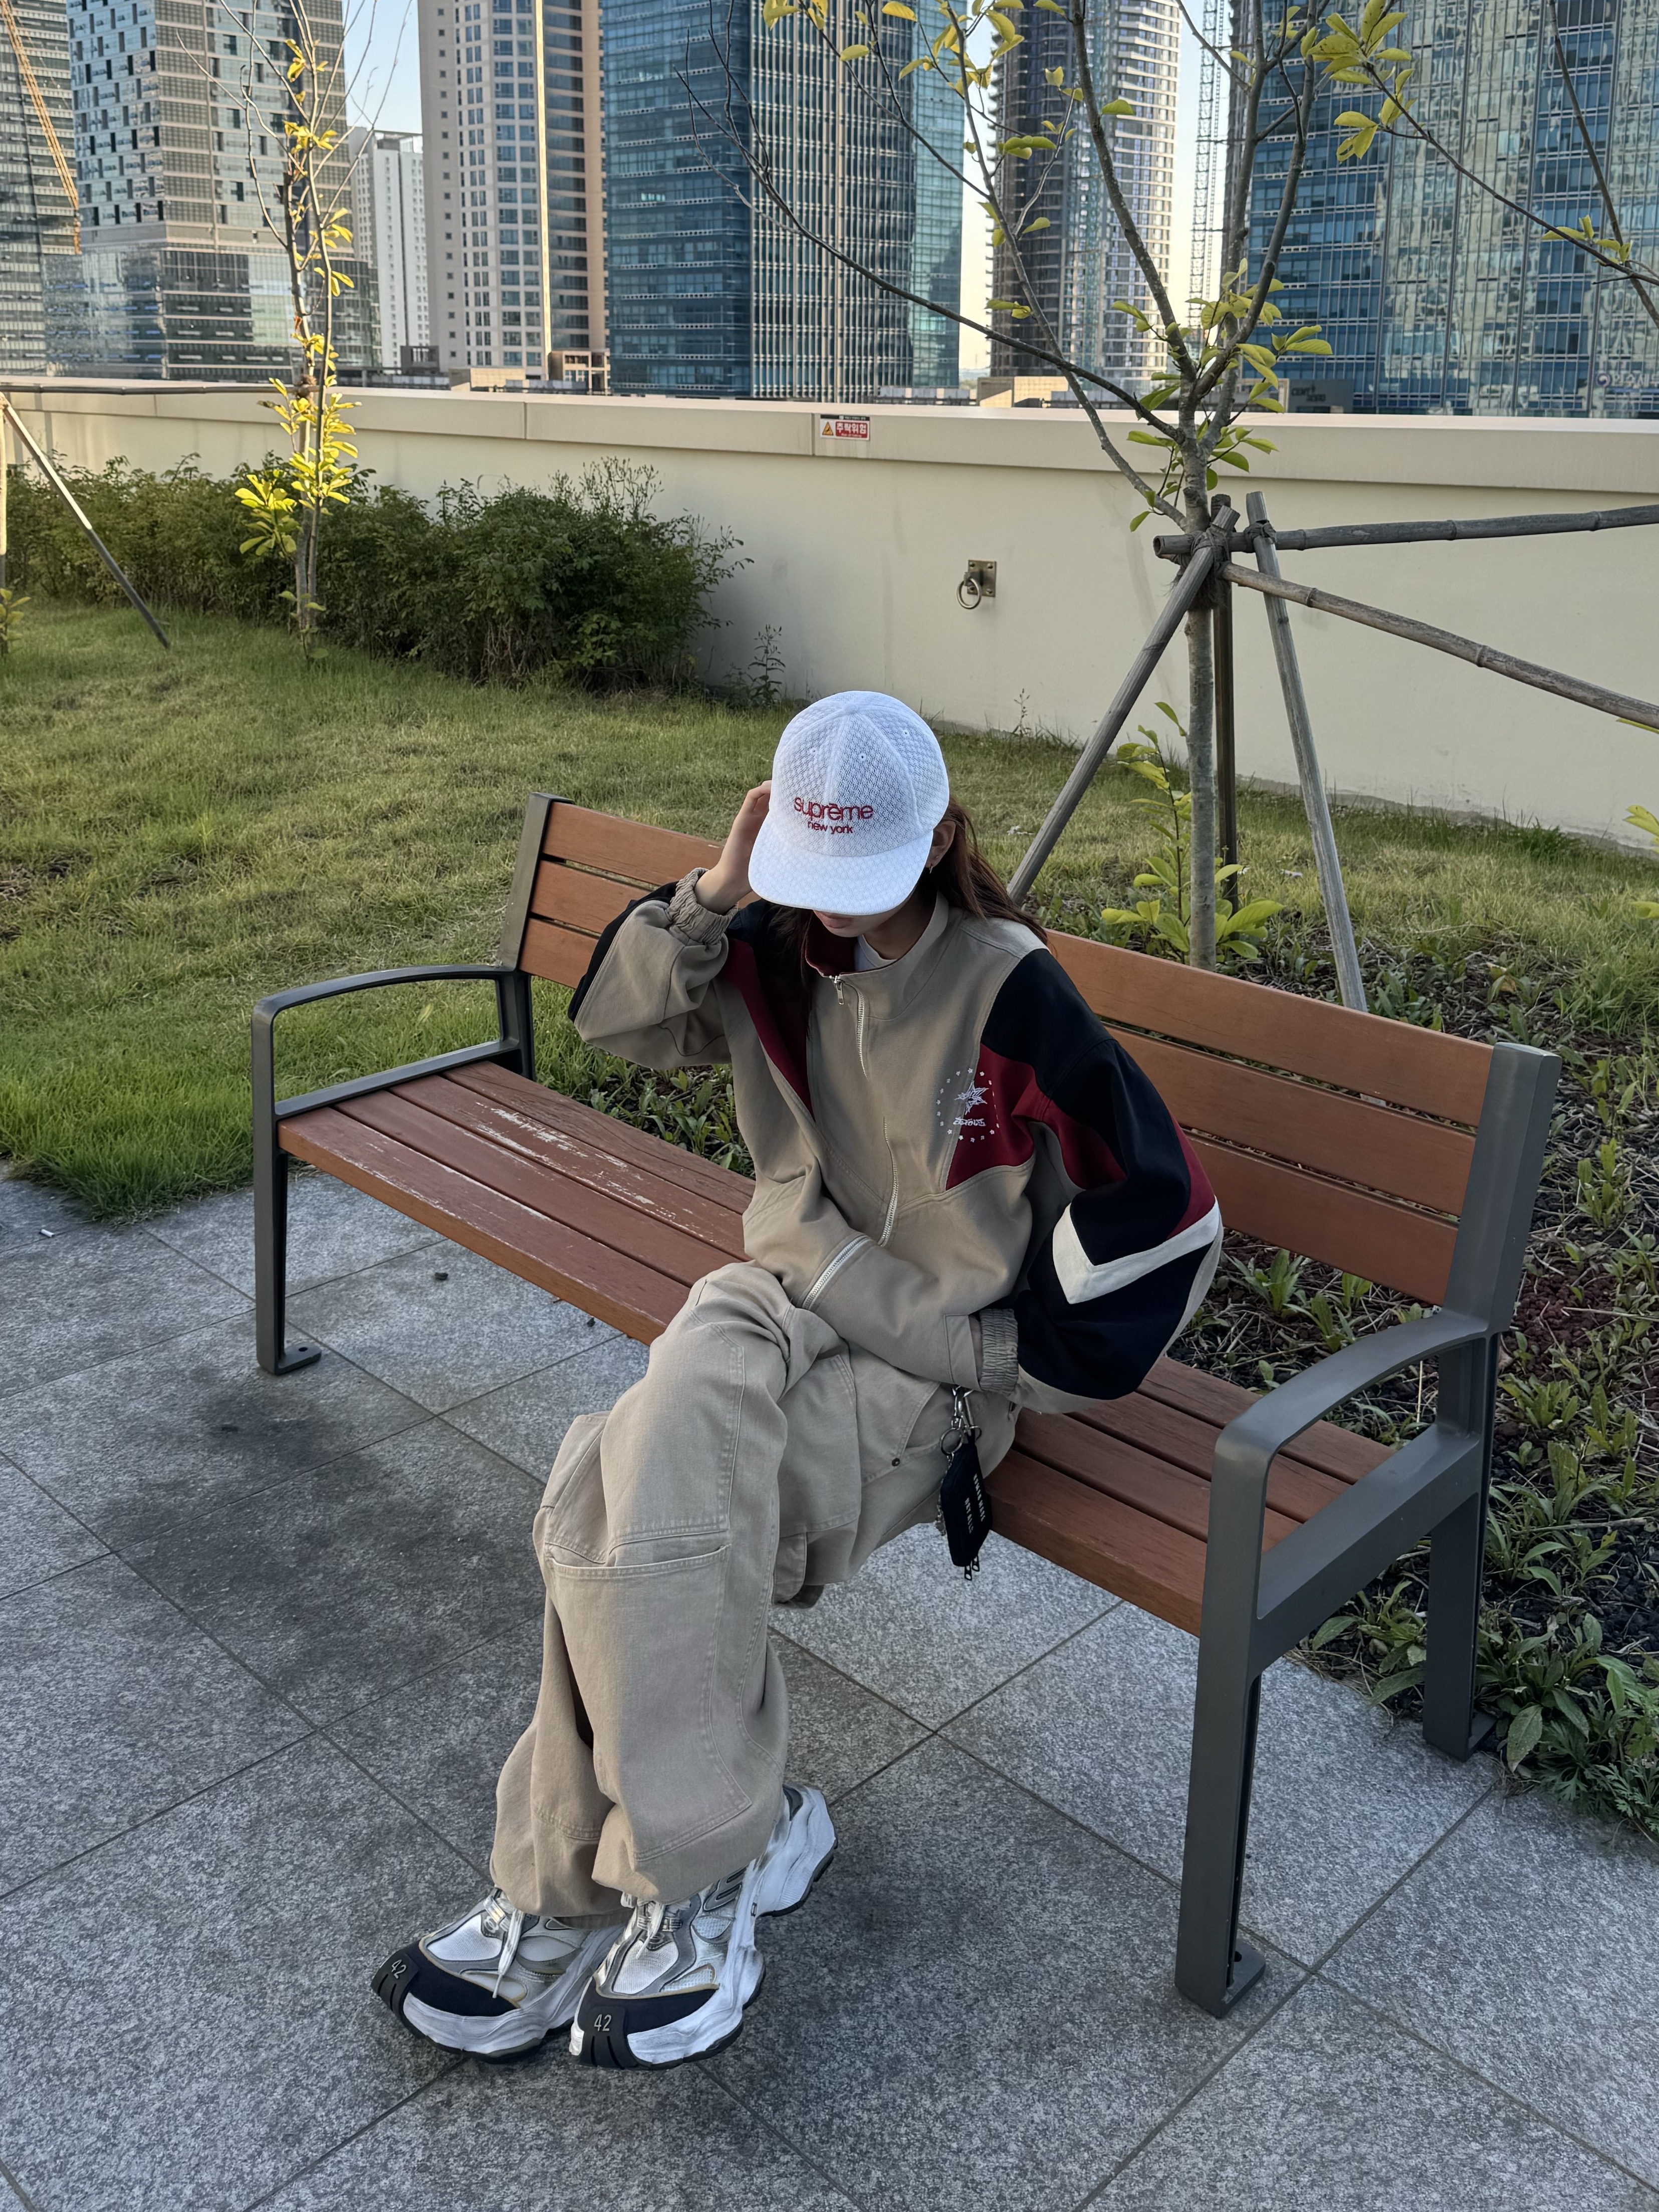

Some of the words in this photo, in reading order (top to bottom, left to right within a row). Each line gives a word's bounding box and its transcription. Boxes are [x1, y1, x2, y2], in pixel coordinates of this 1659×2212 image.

[836, 422, 866, 434] 추락위험
[808, 821, 827, 832] new
[830, 824, 853, 834] york
[391, 1959, 406, 1979] 42
[594, 2014, 612, 2032] 42
